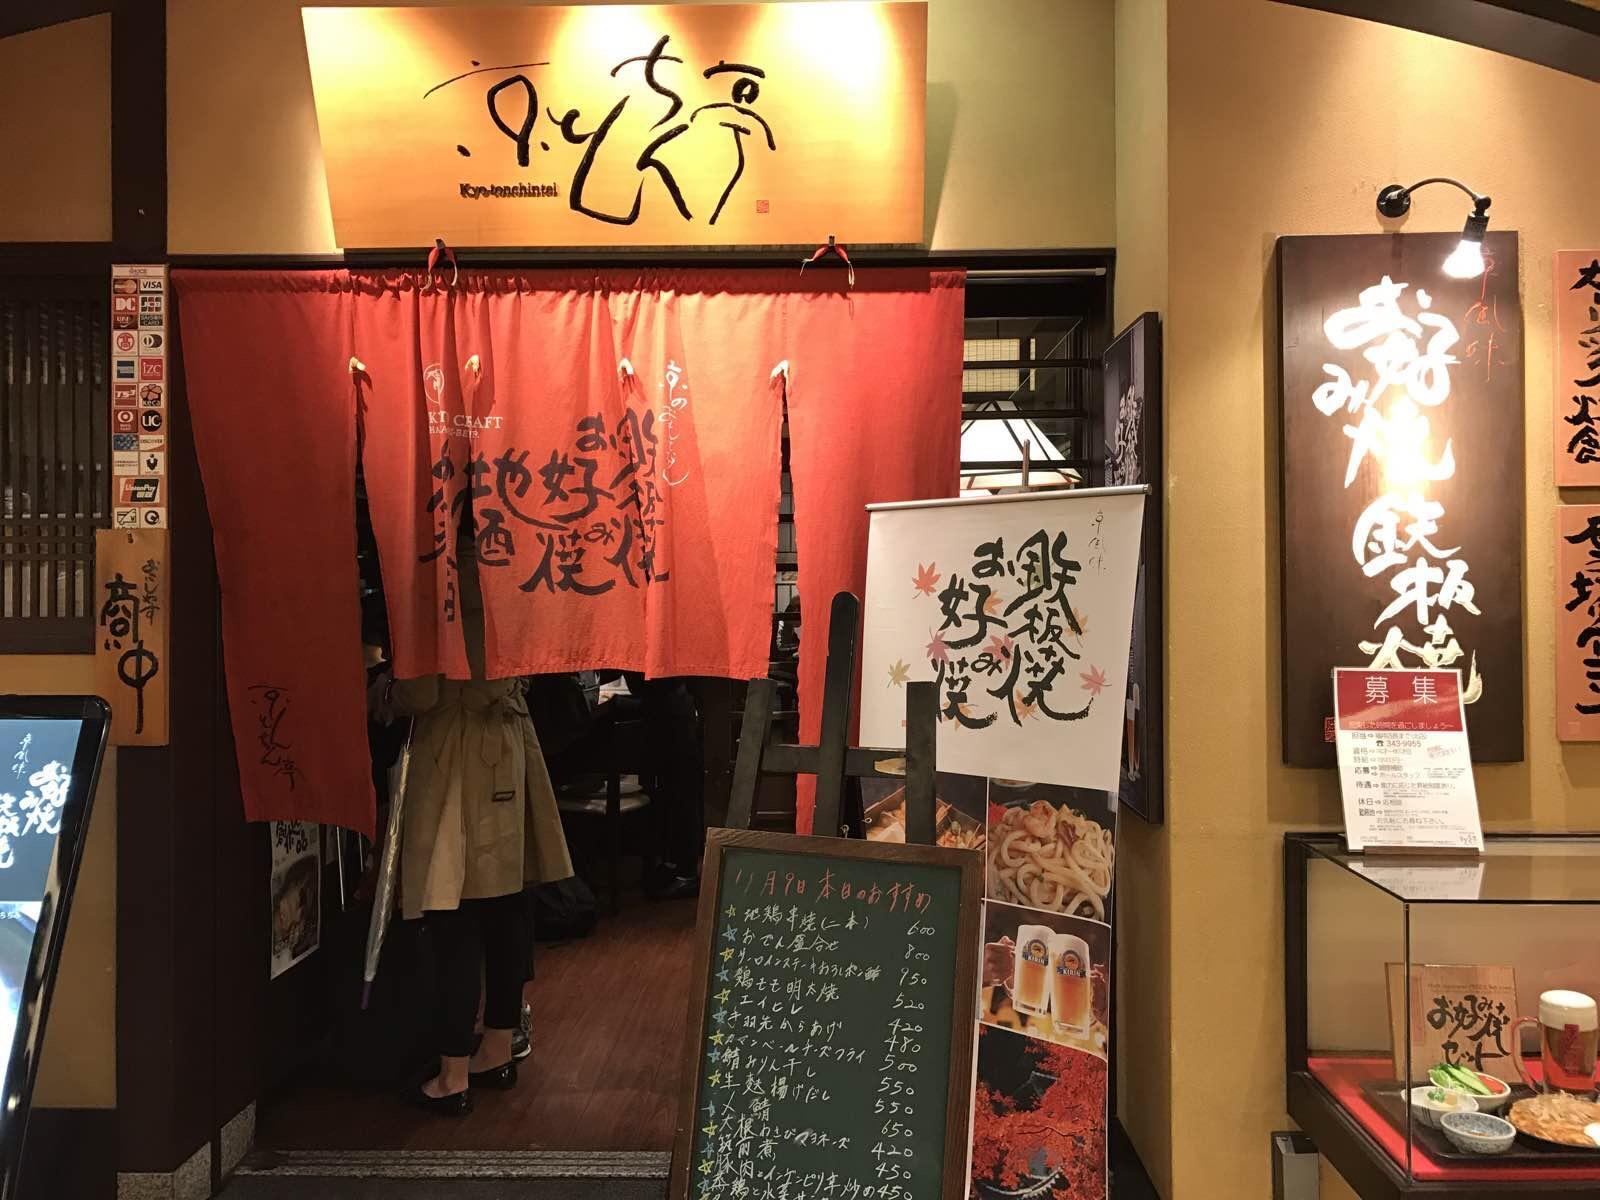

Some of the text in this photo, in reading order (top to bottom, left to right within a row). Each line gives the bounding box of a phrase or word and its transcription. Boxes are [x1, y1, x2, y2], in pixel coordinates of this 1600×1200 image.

[142, 281, 162, 289] VISA
[115, 297, 136, 311] DC
[142, 415, 161, 427] UC
[1365, 675, 1438, 705] 募集
[1358, 797, 1374, 806] 休日
[815, 867, 933, 914] 本日のおすすめ
[907, 919, 936, 936] 600
[904, 943, 930, 961] 800
[899, 967, 927, 986] 950
[892, 992, 925, 1010] 520
[740, 994, 923, 1036] エイヒレ 420
[884, 1034, 921, 1053] 480
[878, 1053, 918, 1072] 500
[877, 1076, 915, 1096] 550
[873, 1099, 914, 1115] 550
[881, 1119, 914, 1138] 650
[871, 1141, 914, 1161] 420
[875, 1161, 912, 1180] 450
[877, 1183, 913, 1200] 450
